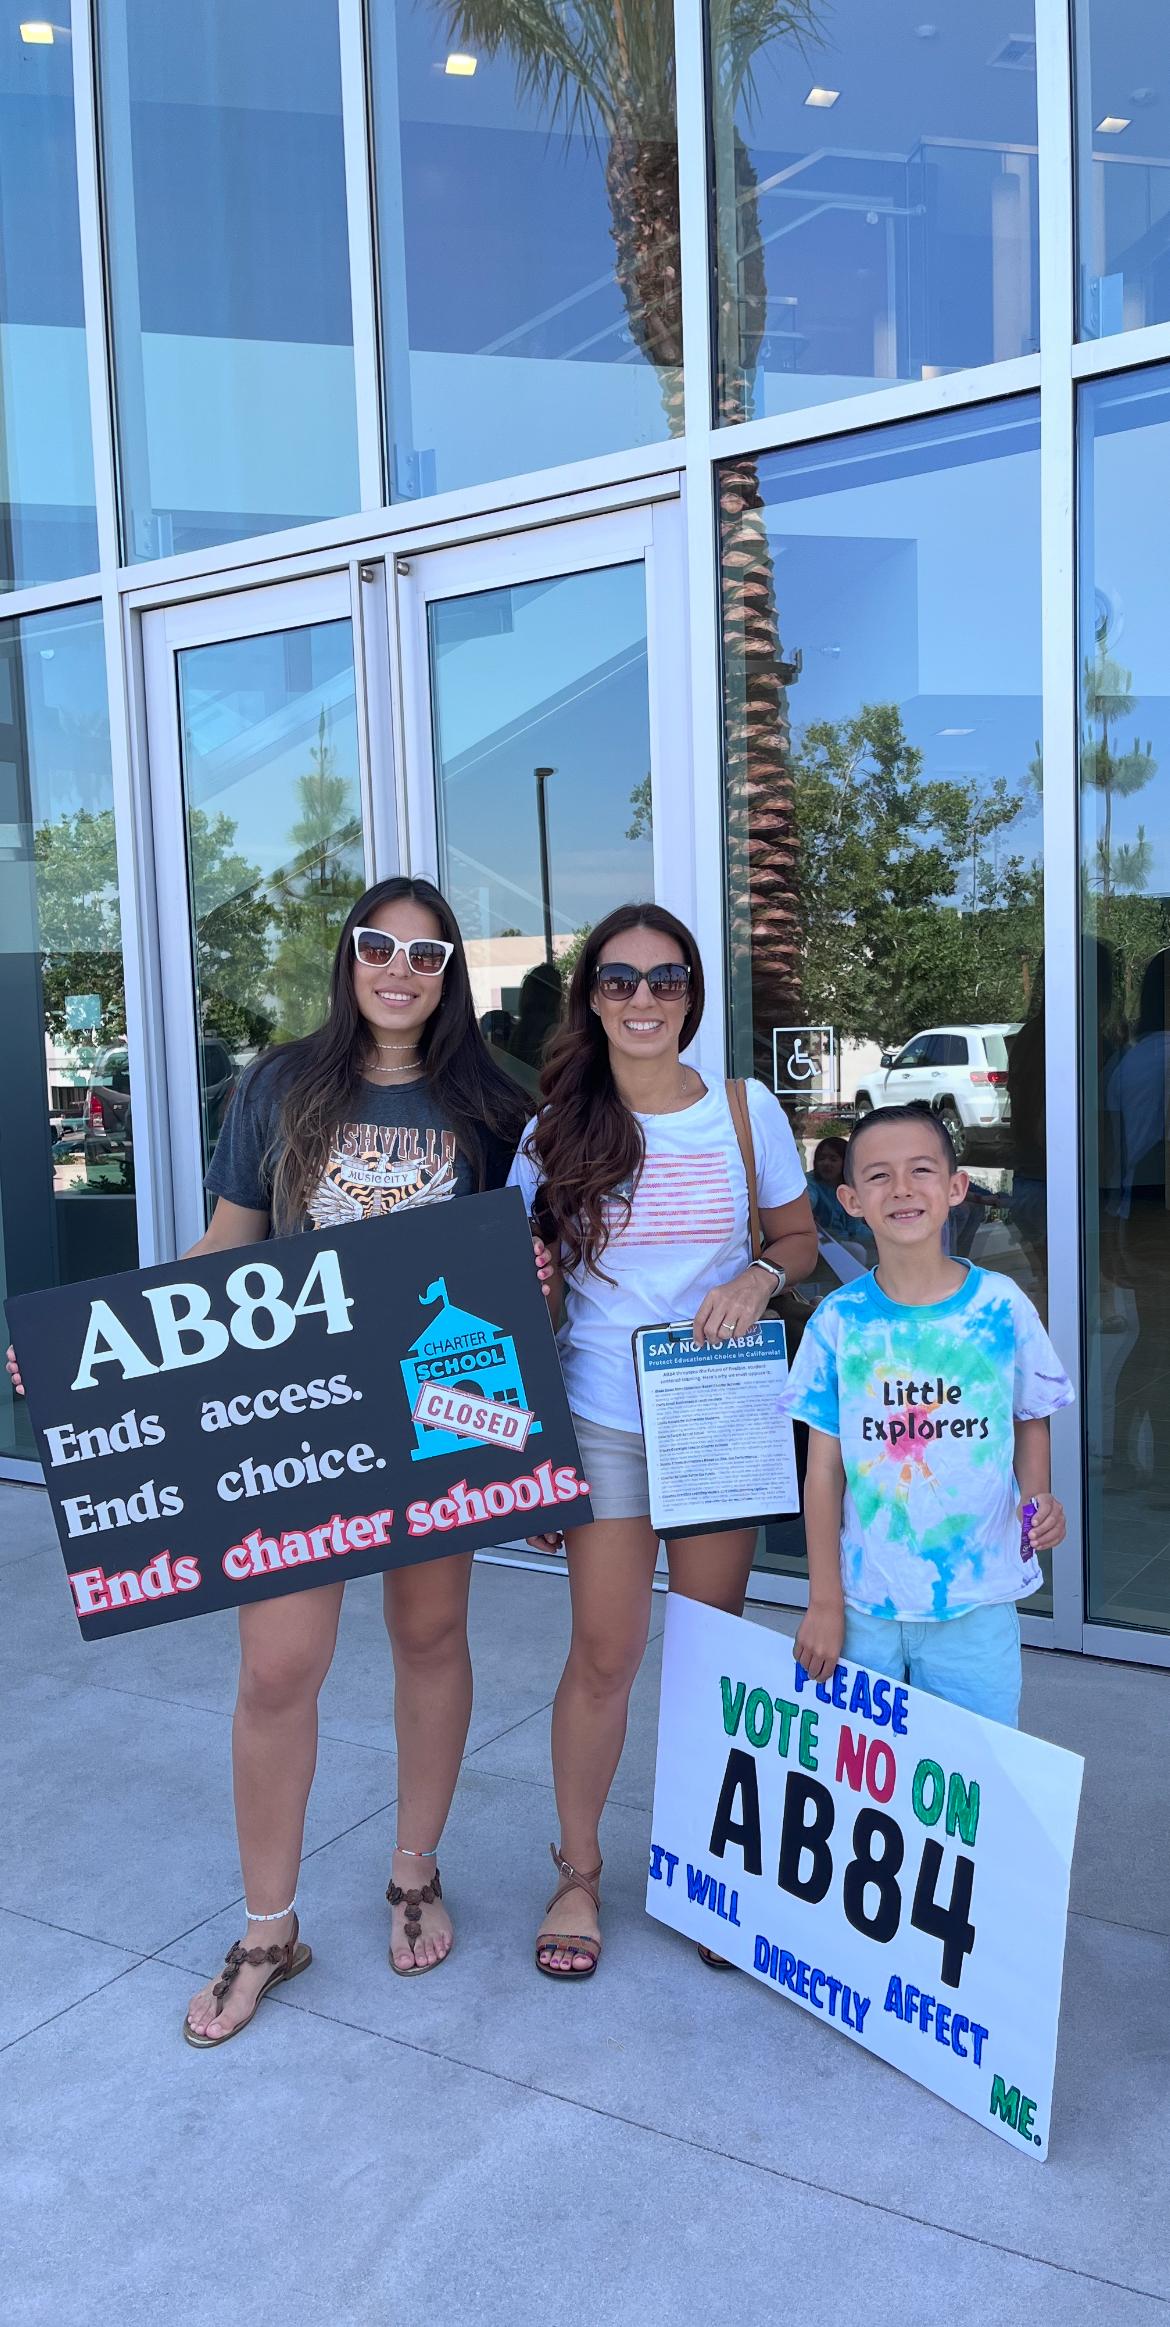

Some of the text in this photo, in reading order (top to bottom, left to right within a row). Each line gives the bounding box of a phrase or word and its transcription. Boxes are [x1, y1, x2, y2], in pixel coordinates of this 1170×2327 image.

[347, 1170, 410, 1184] MUSIC CITY
[70, 1249, 355, 1391] AB84
[424, 1331, 487, 1356] CHARTER
[648, 1342, 676, 1357] SAY
[727, 1335, 764, 1349] AB84
[416, 1348, 505, 1380] SCHOOL
[648, 1359, 673, 1367] Protect
[674, 1355, 713, 1364] Educational
[883, 1377, 962, 1406] Little
[43, 1373, 363, 1468] Ends access.
[427, 1395, 519, 1438] CLOSED
[862, 1412, 989, 1446] Explorers
[61, 1441, 387, 1538] Ends choice.
[69, 1458, 591, 1618] Ends charter schools.
[794, 1660, 909, 1736] PLEASE
[720, 1676, 980, 1847] VOTE NO ON
[650, 1844, 741, 1928] IT WILL
[708, 1747, 976, 1989] AB84
[753, 1934, 989, 2067] DIRECTLY AFFECT
[989, 2074, 1042, 2147] ME.
